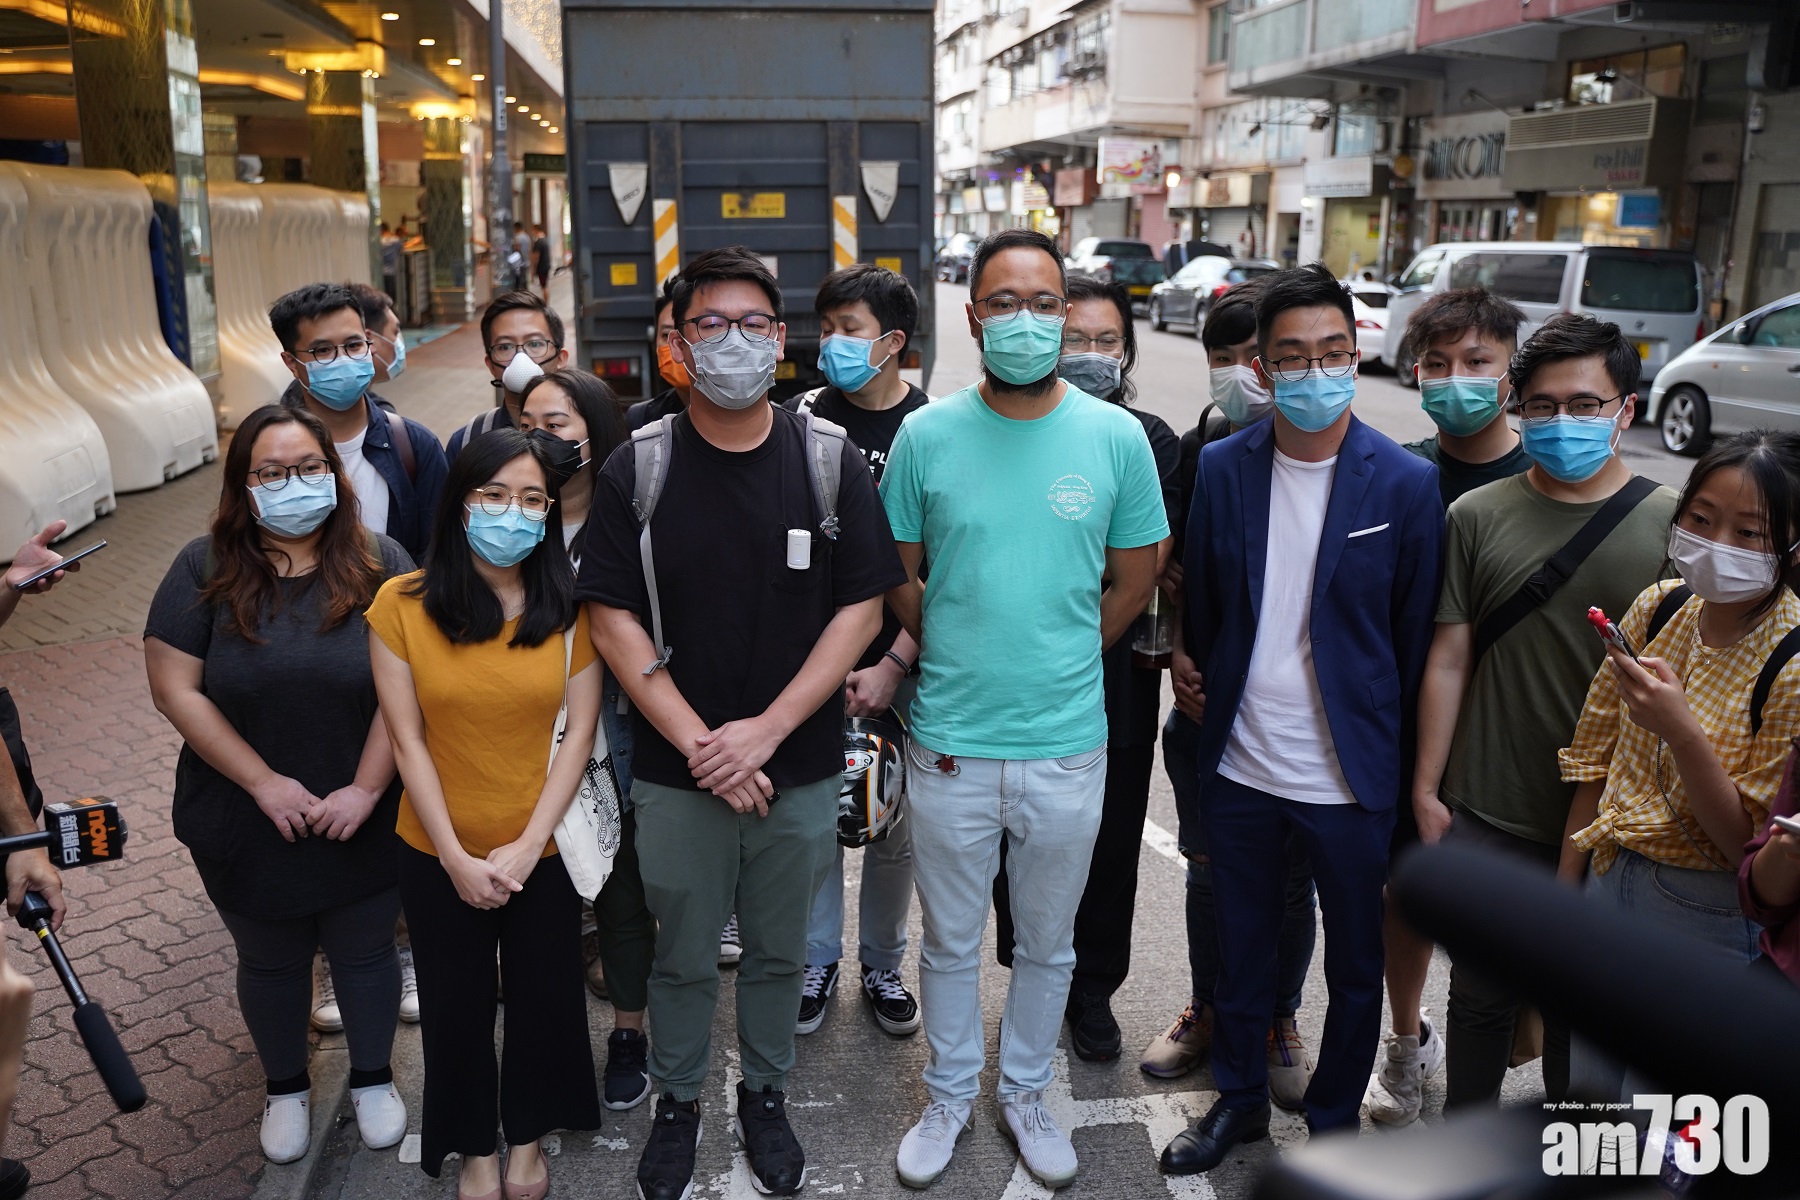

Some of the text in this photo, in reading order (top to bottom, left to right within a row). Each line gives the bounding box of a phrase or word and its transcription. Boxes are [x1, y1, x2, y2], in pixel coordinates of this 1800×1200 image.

[59, 814, 81, 864] 新聞台
[88, 809, 109, 856] now
